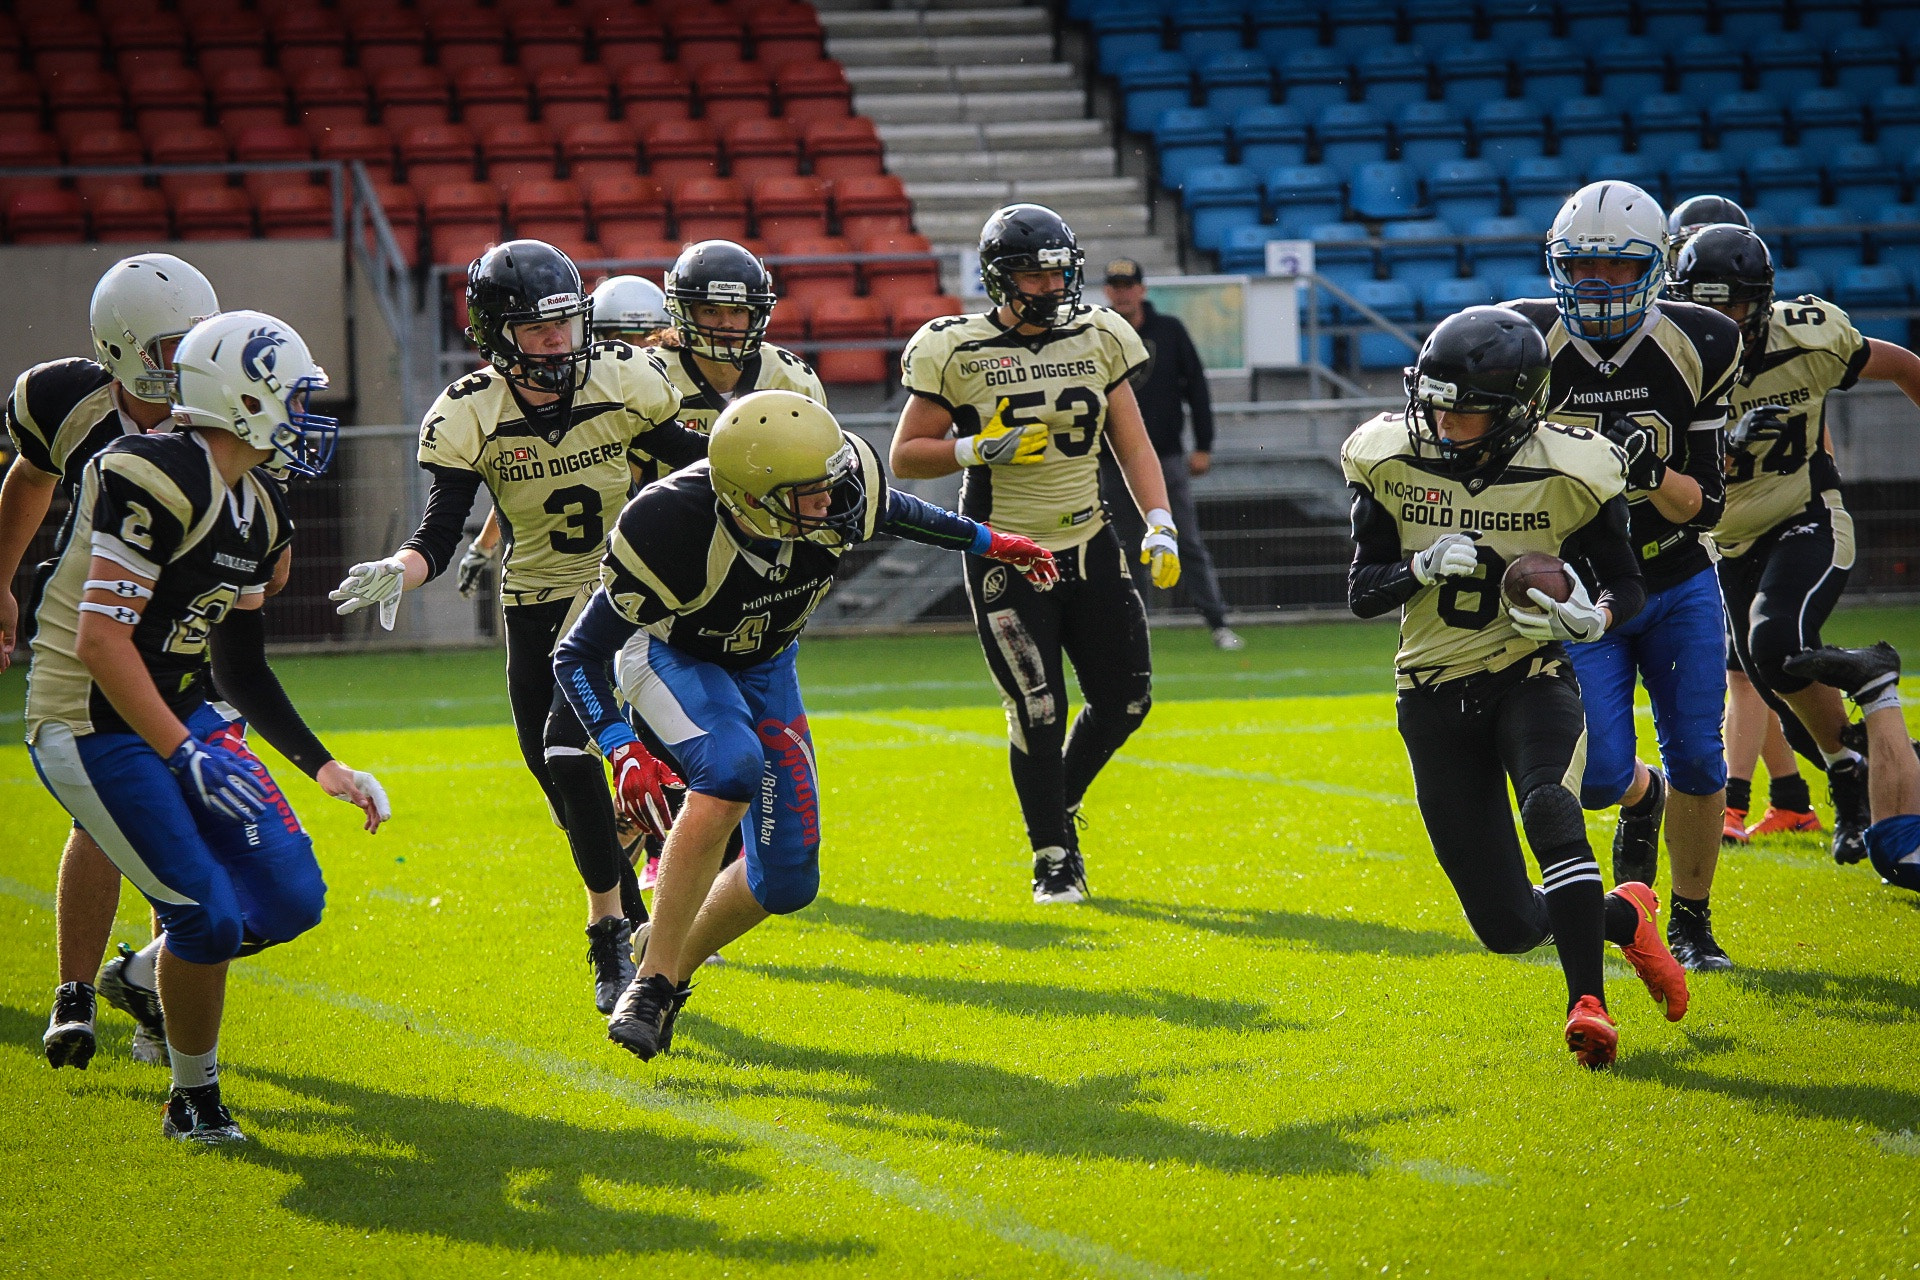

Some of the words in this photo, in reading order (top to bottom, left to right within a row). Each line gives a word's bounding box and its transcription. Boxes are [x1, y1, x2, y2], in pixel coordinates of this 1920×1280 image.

[547, 294, 570, 306] Riddell
[985, 367, 1028, 387] GOLD
[1032, 359, 1097, 380] DIGGERS
[1573, 386, 1650, 405] MONARCHS
[995, 385, 1102, 458] 53
[499, 461, 546, 483] GOLD
[548, 441, 624, 477] DIGGERS
[543, 484, 603, 555] 3
[1401, 503, 1454, 528] GOLD
[1459, 508, 1551, 533] DIGGERS
[742, 577, 819, 611] MONARCHS
[1437, 545, 1507, 631] 8
[162, 582, 239, 654] 2
[760, 816, 776, 846] Mau
